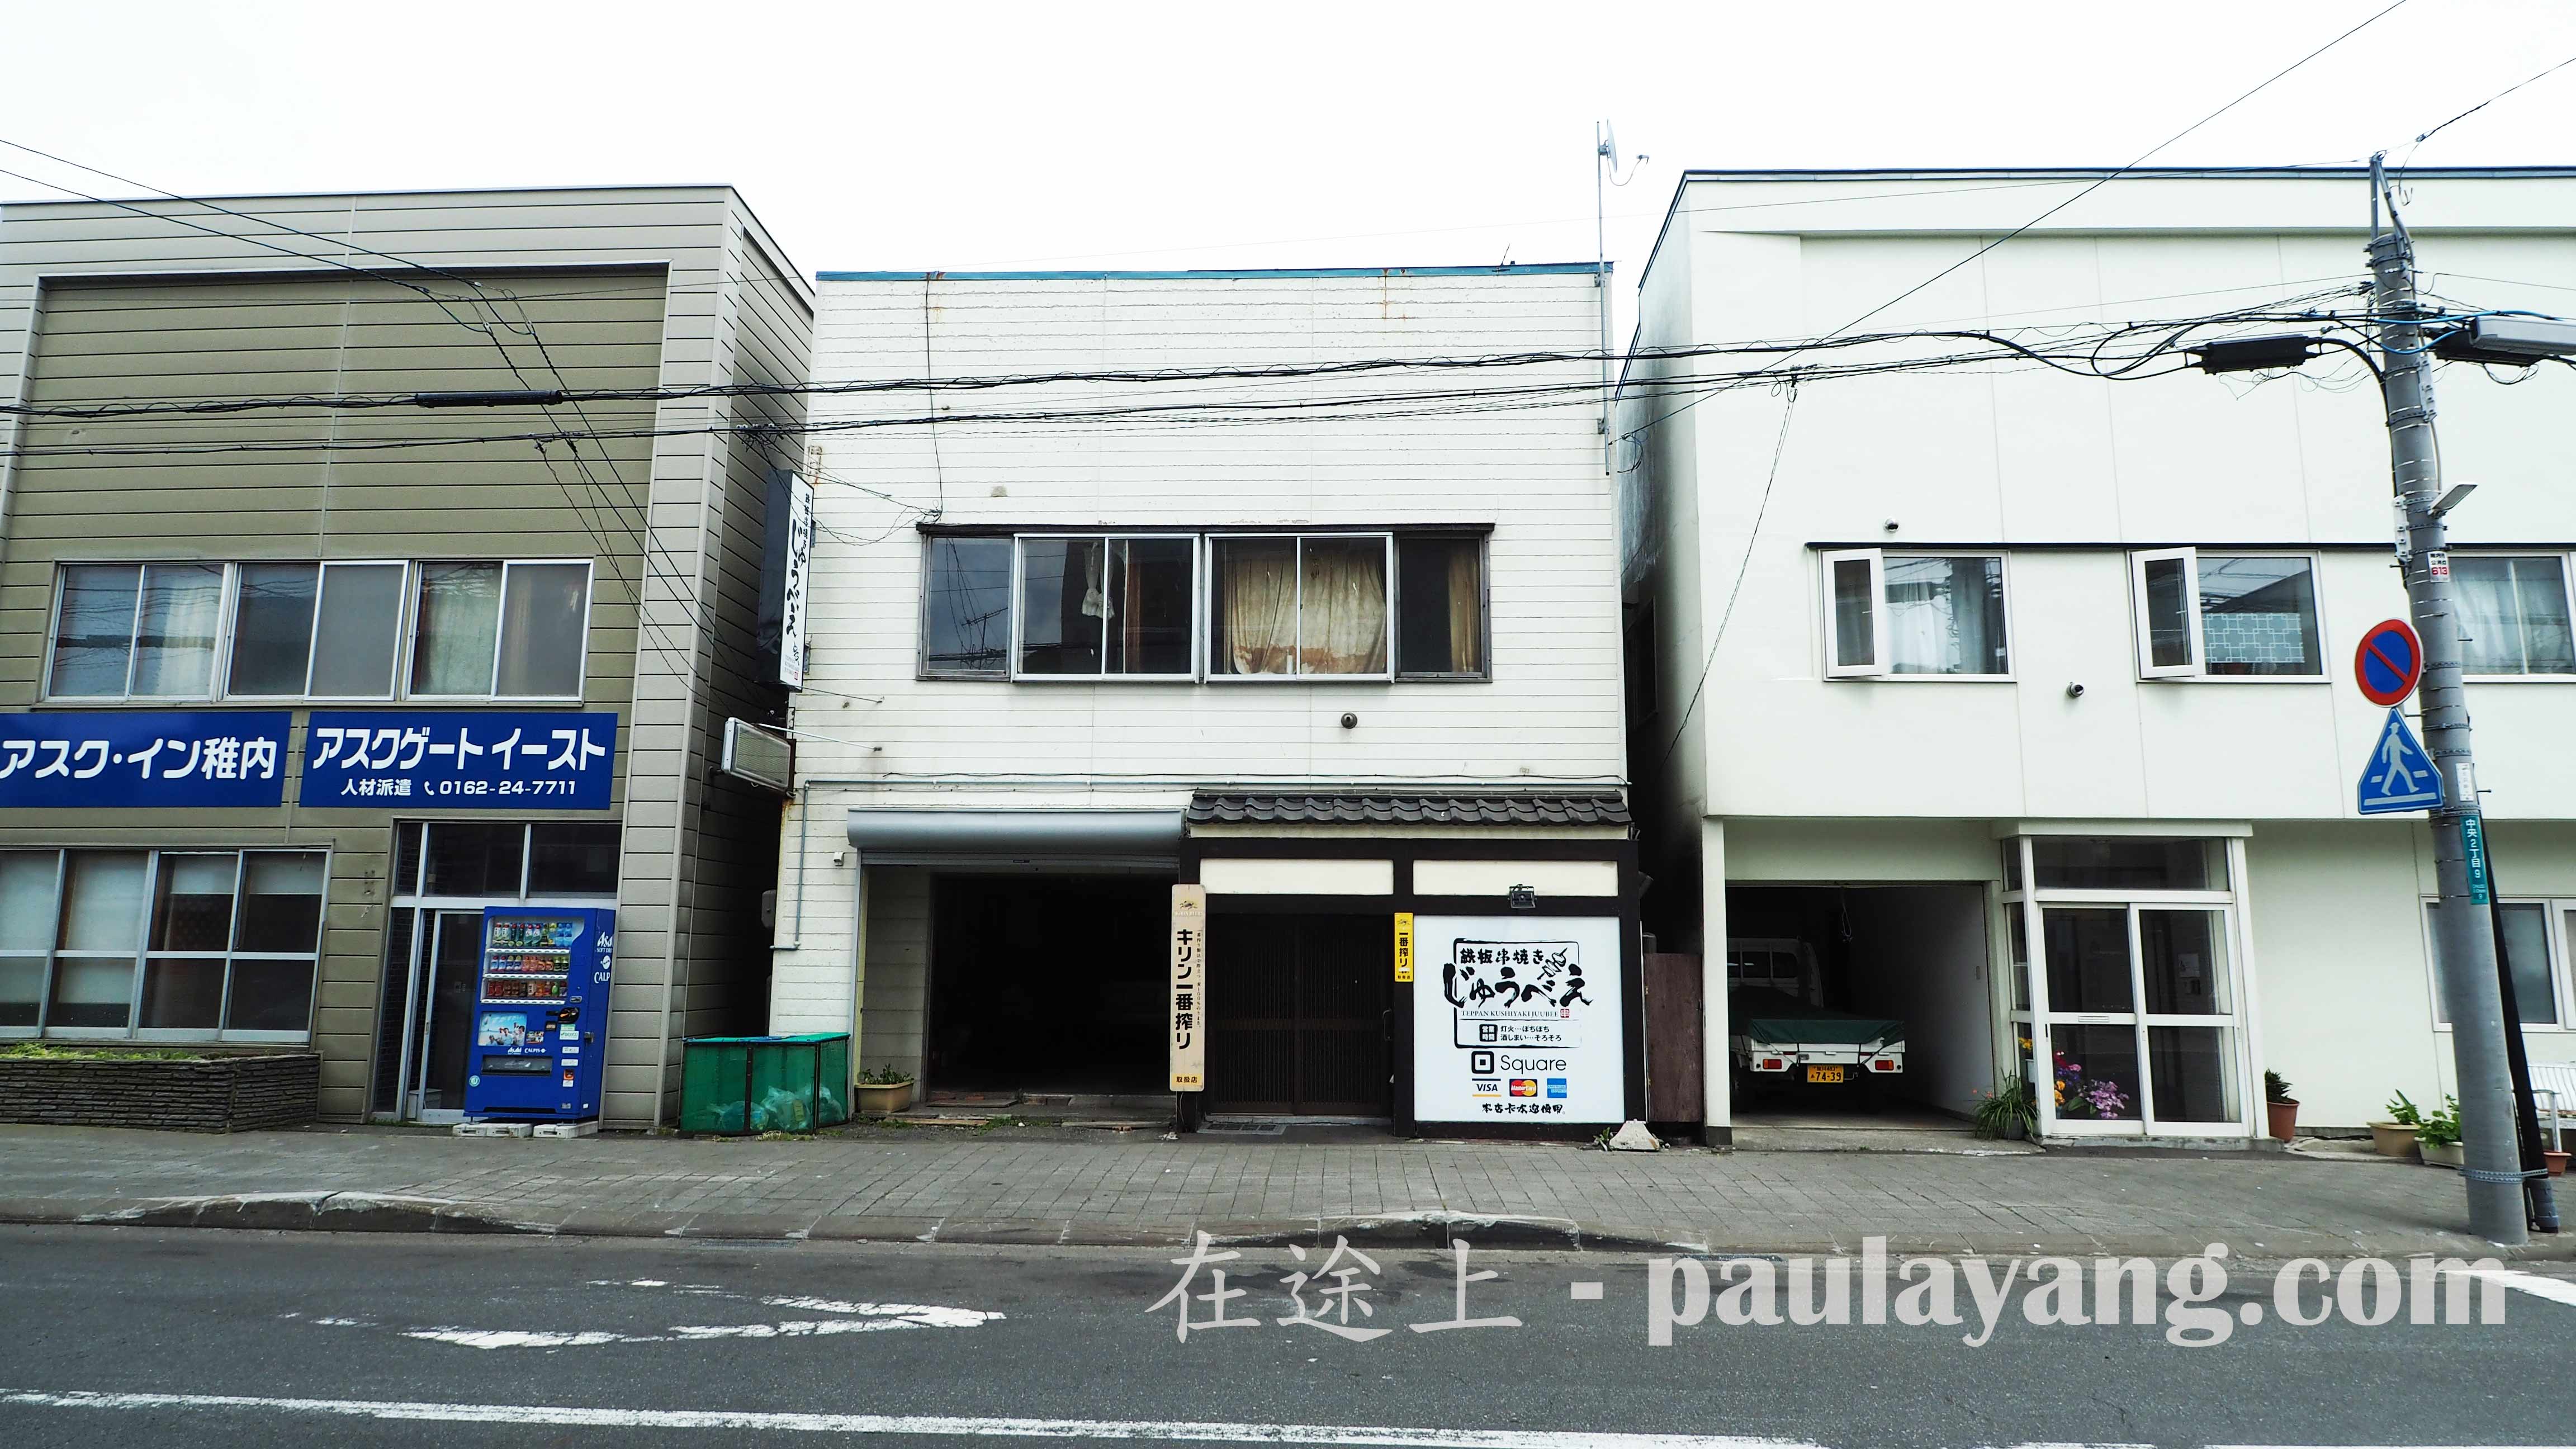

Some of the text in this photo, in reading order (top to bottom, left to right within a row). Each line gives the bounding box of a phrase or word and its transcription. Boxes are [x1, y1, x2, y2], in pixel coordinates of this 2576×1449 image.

[0, 736, 277, 780] アスク・イン稚内
[340, 778, 575, 796] 人材派遣 0162-24-7711
[1399, 932, 1409, 968] 一番搾り
[1175, 929, 1194, 1050] キリン一番搾り
[1442, 963, 1594, 1008] じゅうべえ
[1500, 1055, 1566, 1074] Square
[1816, 1072, 1841, 1081] 74-39
[1476, 1083, 1498, 1092] VISA
